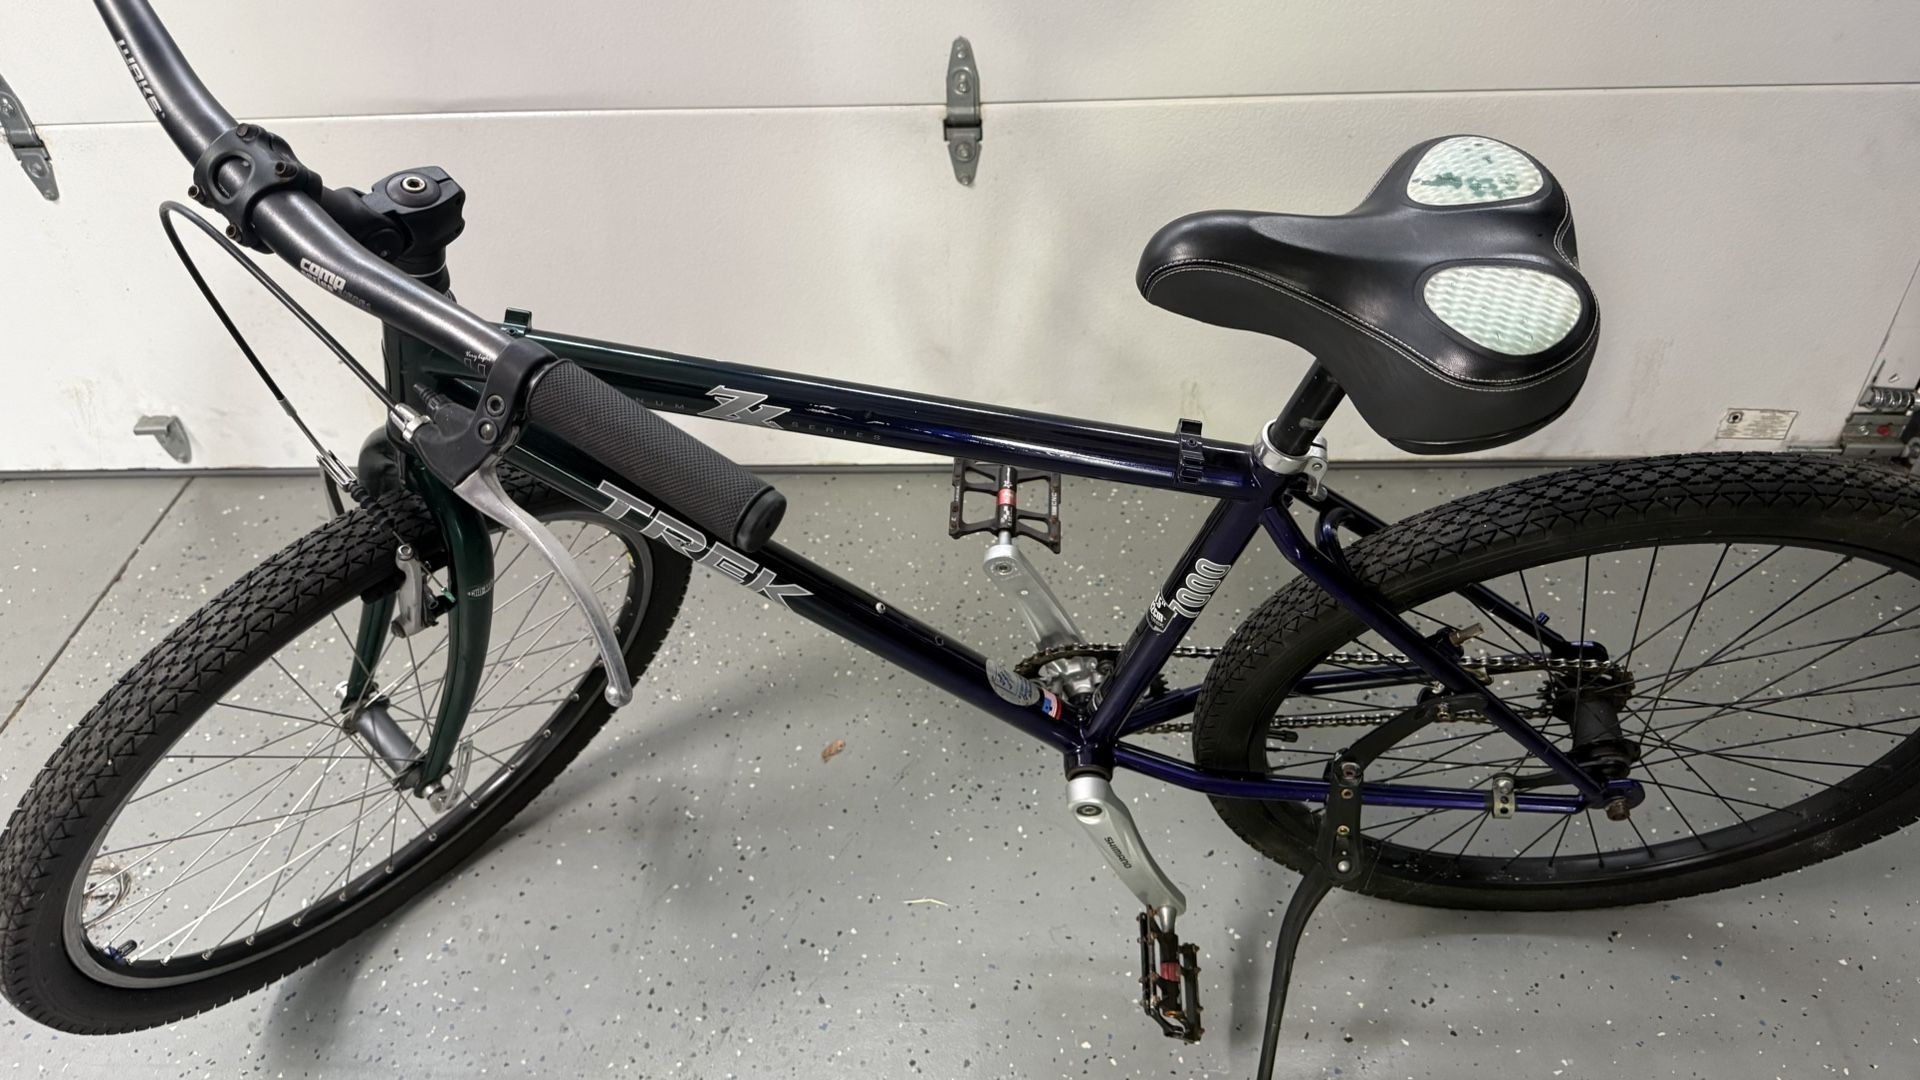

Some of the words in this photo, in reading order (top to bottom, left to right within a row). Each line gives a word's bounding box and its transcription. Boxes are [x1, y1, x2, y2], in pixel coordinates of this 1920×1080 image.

[300, 257, 347, 292] comp
[791, 421, 881, 441] SERIES
[597, 479, 815, 614] TREK
[1168, 558, 1232, 619] 7000
[1104, 836, 1132, 869] SHIMANO
